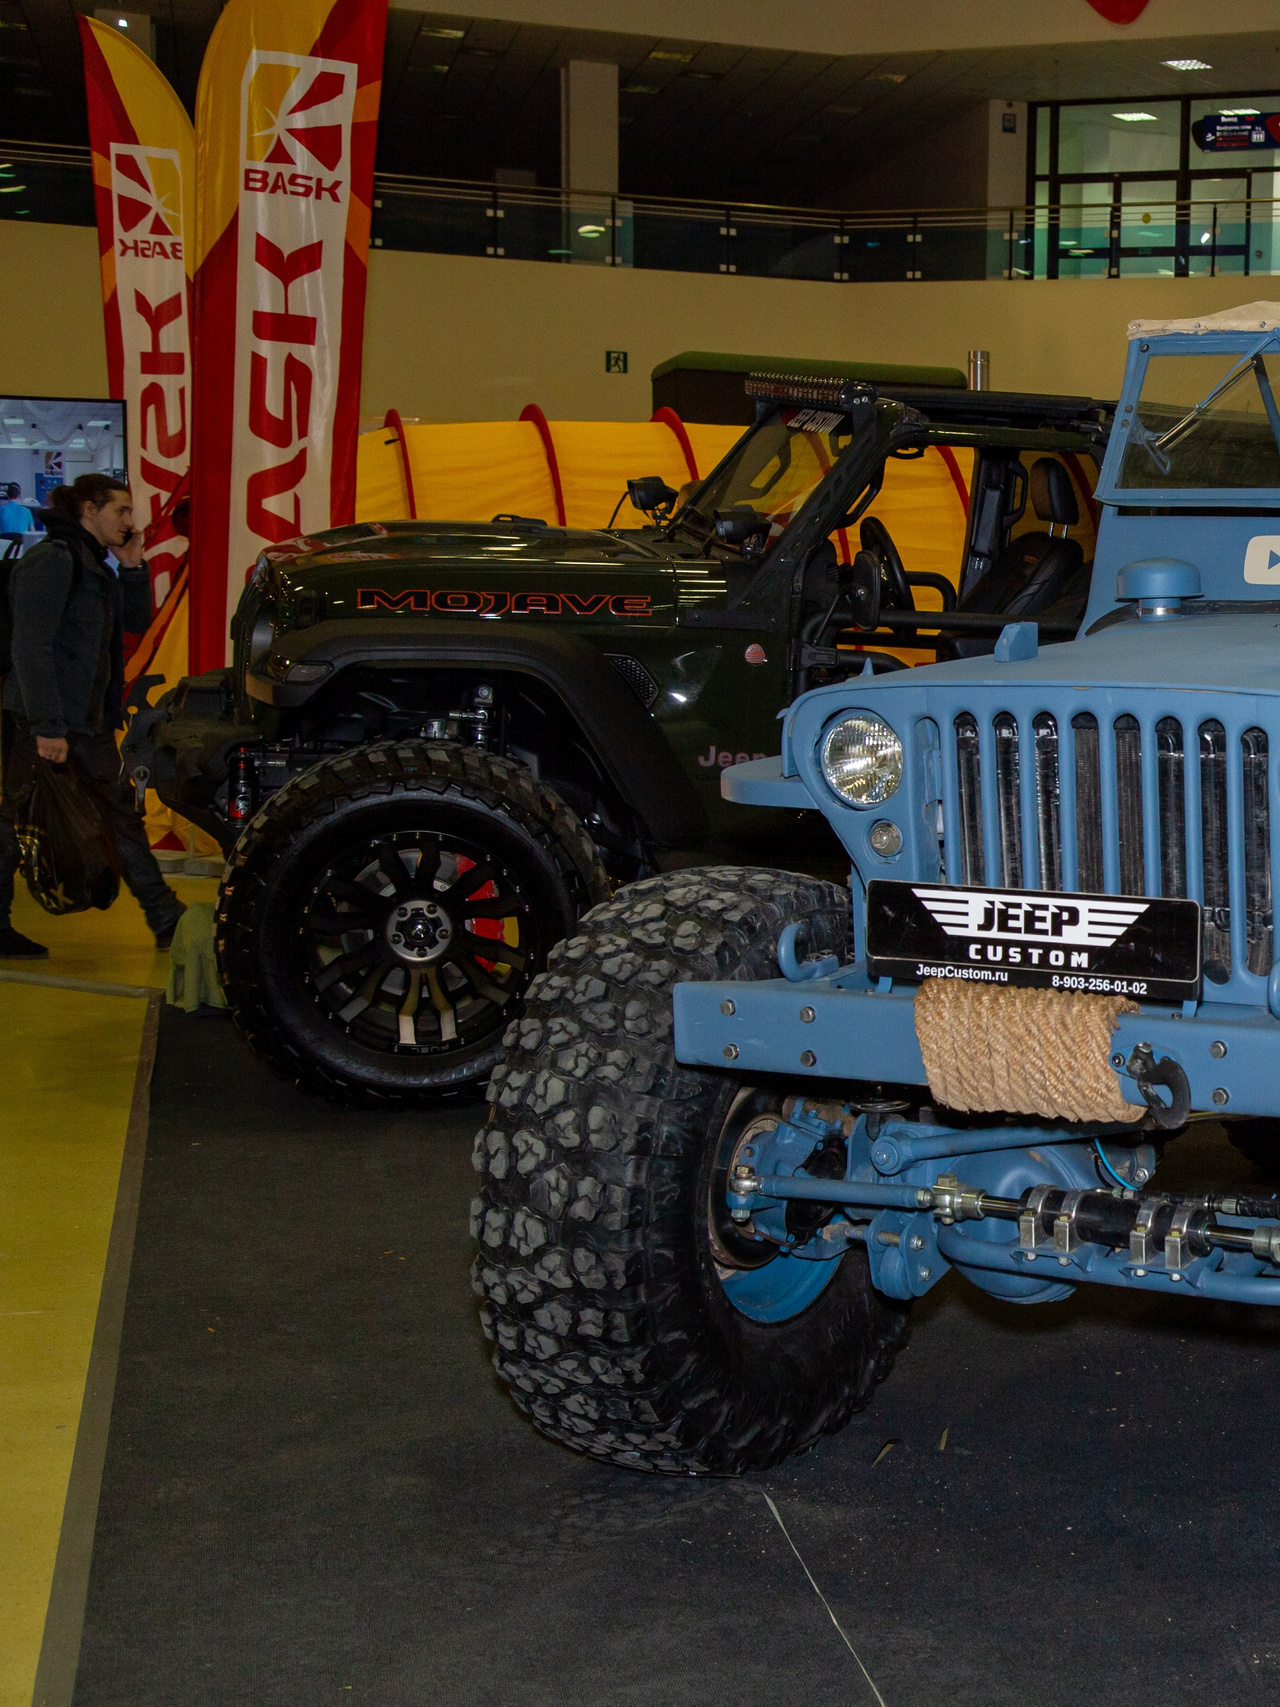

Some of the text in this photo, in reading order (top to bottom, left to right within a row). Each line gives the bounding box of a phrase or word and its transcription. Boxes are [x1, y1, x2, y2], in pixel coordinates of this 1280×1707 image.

[243, 168, 342, 203] BASK
[245, 231, 323, 580] ASK
[357, 588, 652, 616] MOJAVE
[977, 899, 1080, 937] JEEP
[969, 943, 1089, 968] CUSTOM
[916, 963, 1148, 995] JeepCustom.ru 8-903-256-01-02
